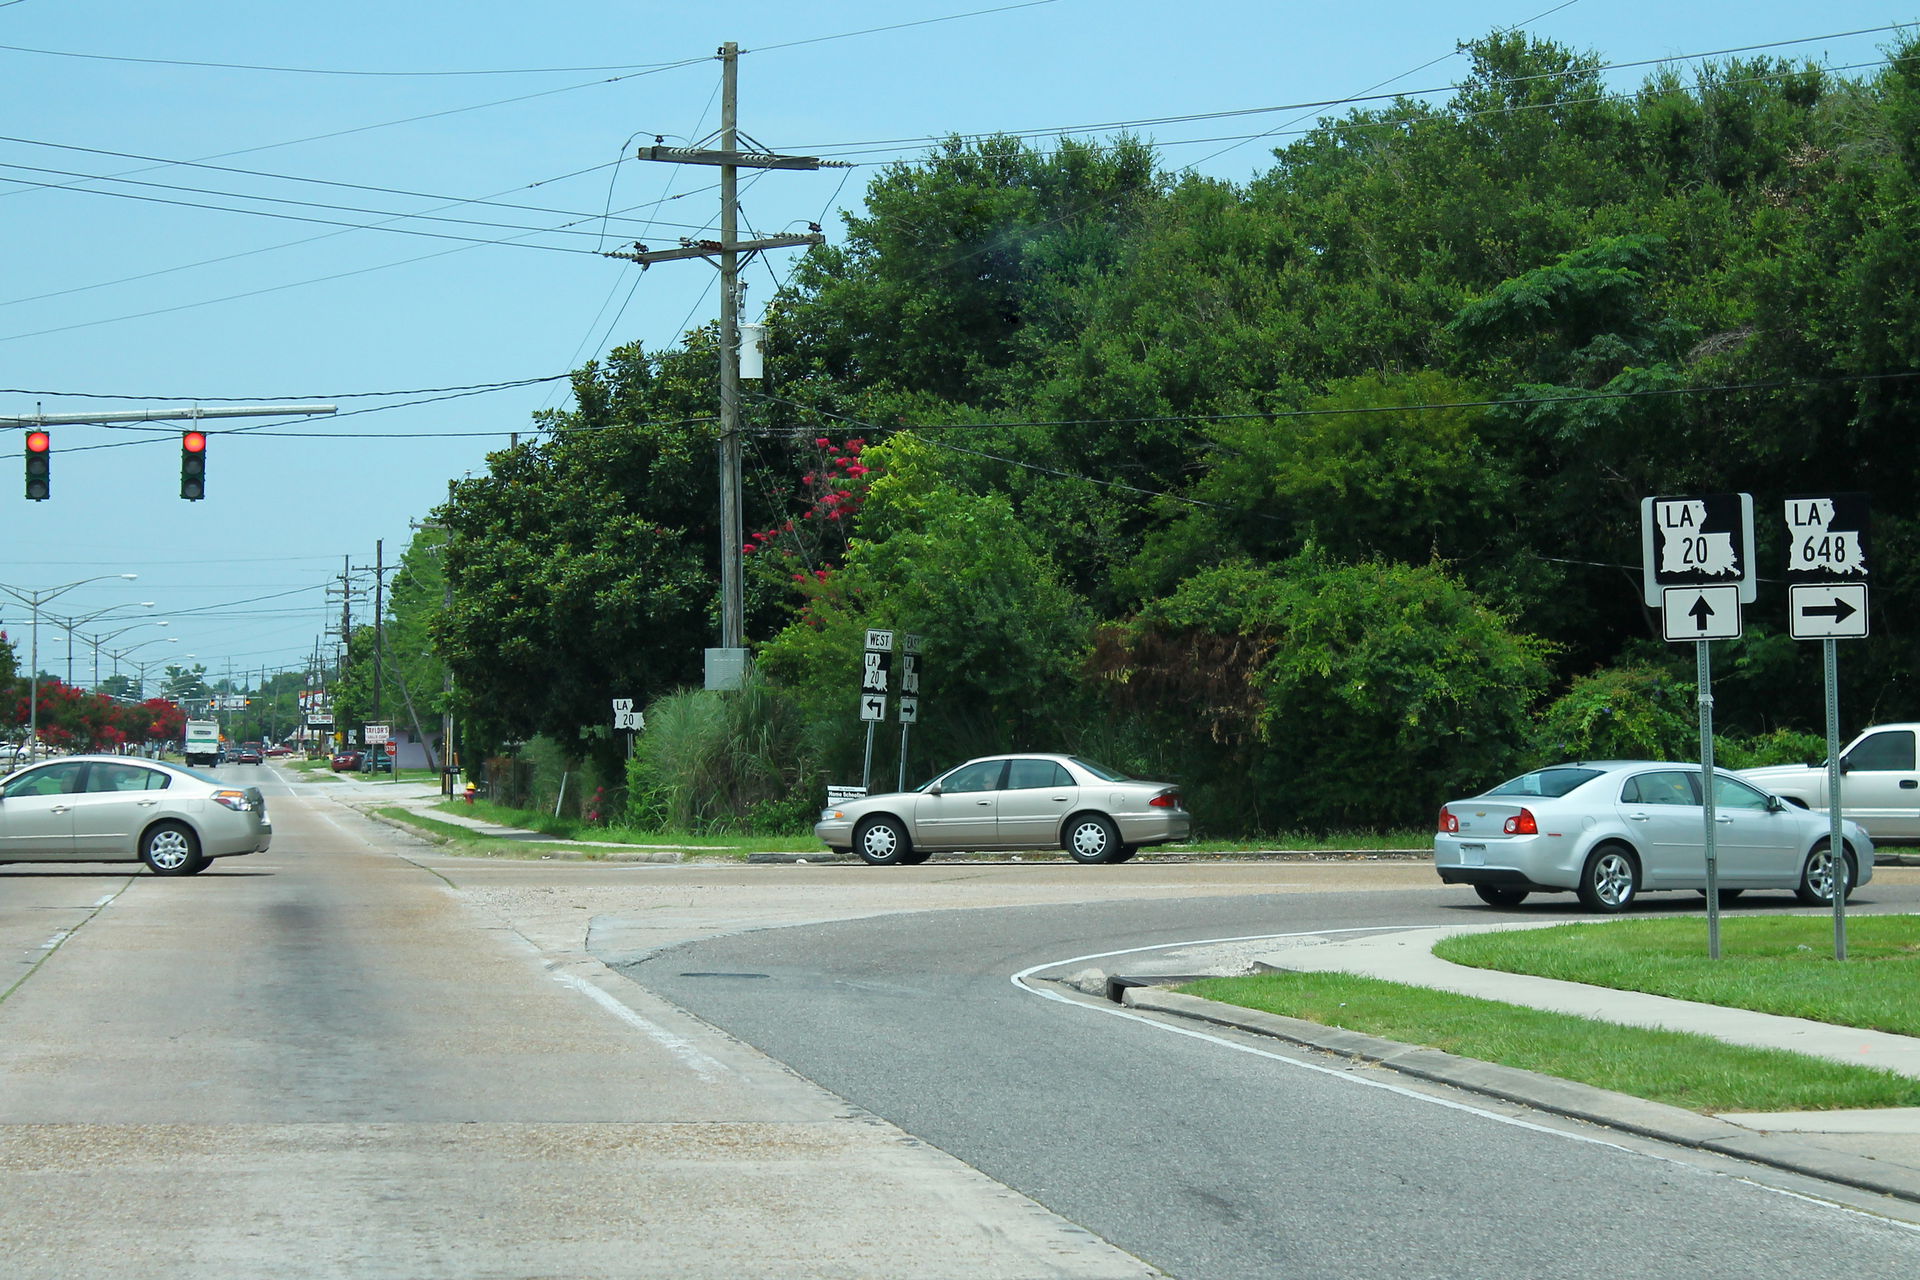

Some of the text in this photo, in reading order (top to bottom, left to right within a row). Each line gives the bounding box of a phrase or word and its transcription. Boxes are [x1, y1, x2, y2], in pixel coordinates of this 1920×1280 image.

[1665, 504, 1694, 529] LA
[1794, 502, 1822, 527] LA
[1682, 536, 1708, 564] 20
[1802, 535, 1846, 563] 648
[870, 633, 890, 646] WEST
[867, 655, 876, 666] LA
[870, 670, 879, 684] 20
[616, 700, 628, 710] LA
[623, 714, 634, 725] 20
